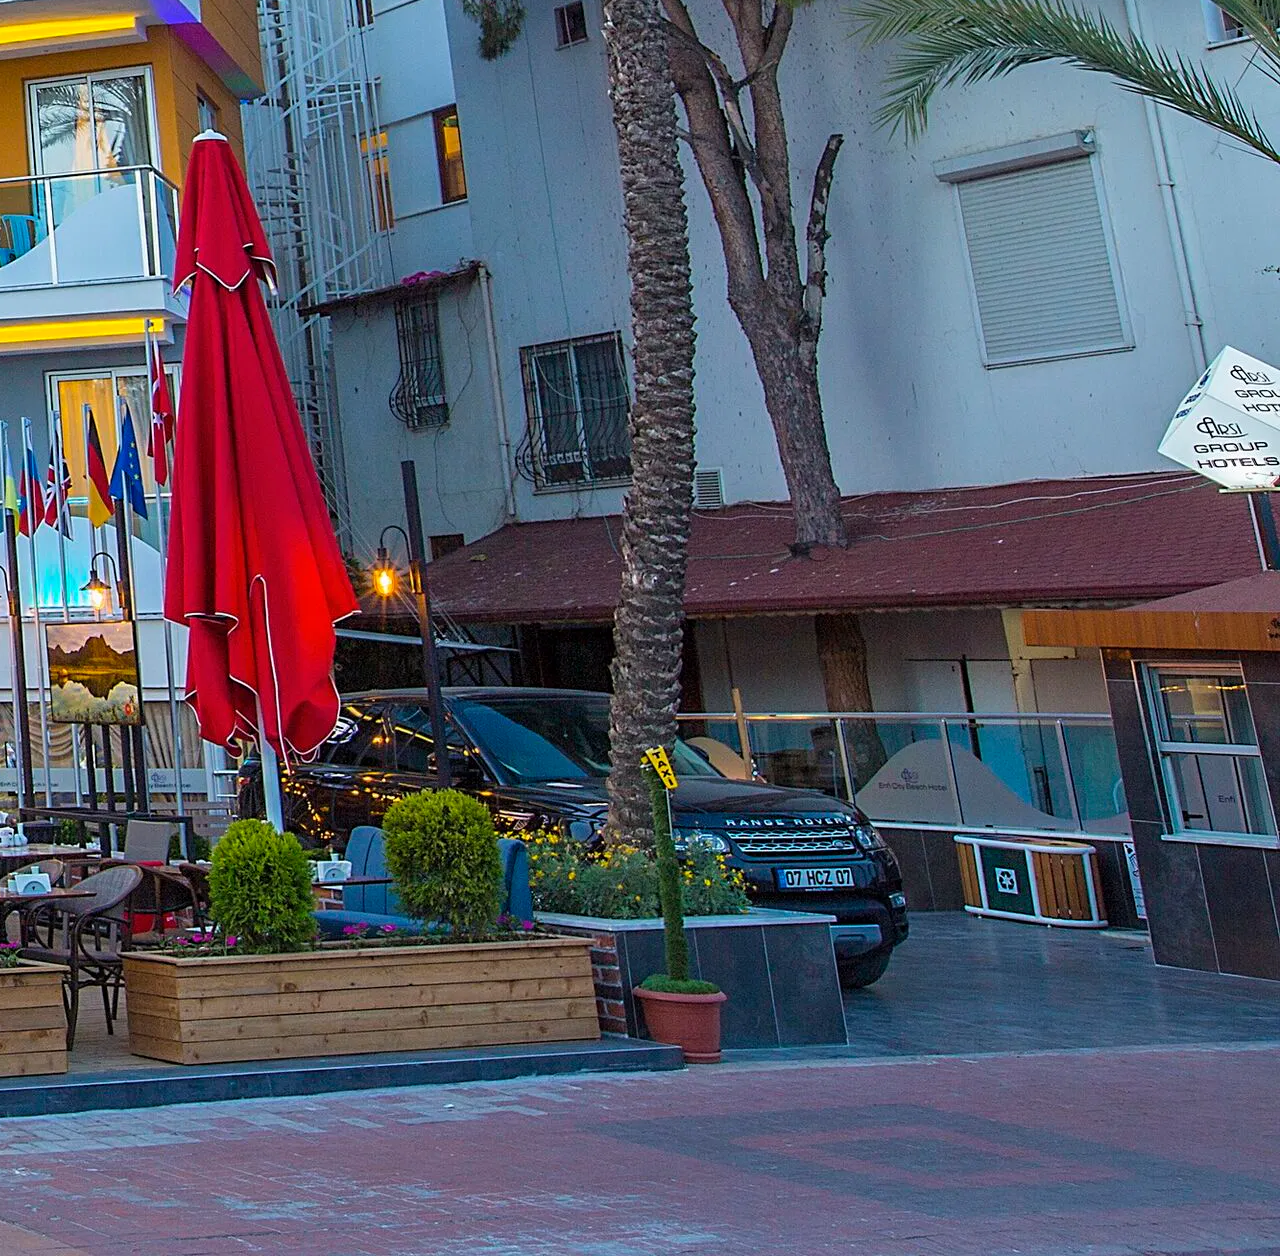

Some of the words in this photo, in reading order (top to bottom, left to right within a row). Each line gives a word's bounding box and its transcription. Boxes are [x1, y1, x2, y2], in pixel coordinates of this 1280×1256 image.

[1234, 389, 1280, 398] GROU
[1193, 442, 1269, 454] GROUP
[1196, 456, 1280, 469] HOTELS
[652, 751, 675, 786] TAXI
[793, 817, 844, 825] ROVER
[785, 870, 802, 885] 07
[806, 870, 832, 885] HCZ
[835, 869, 851, 885] 07
